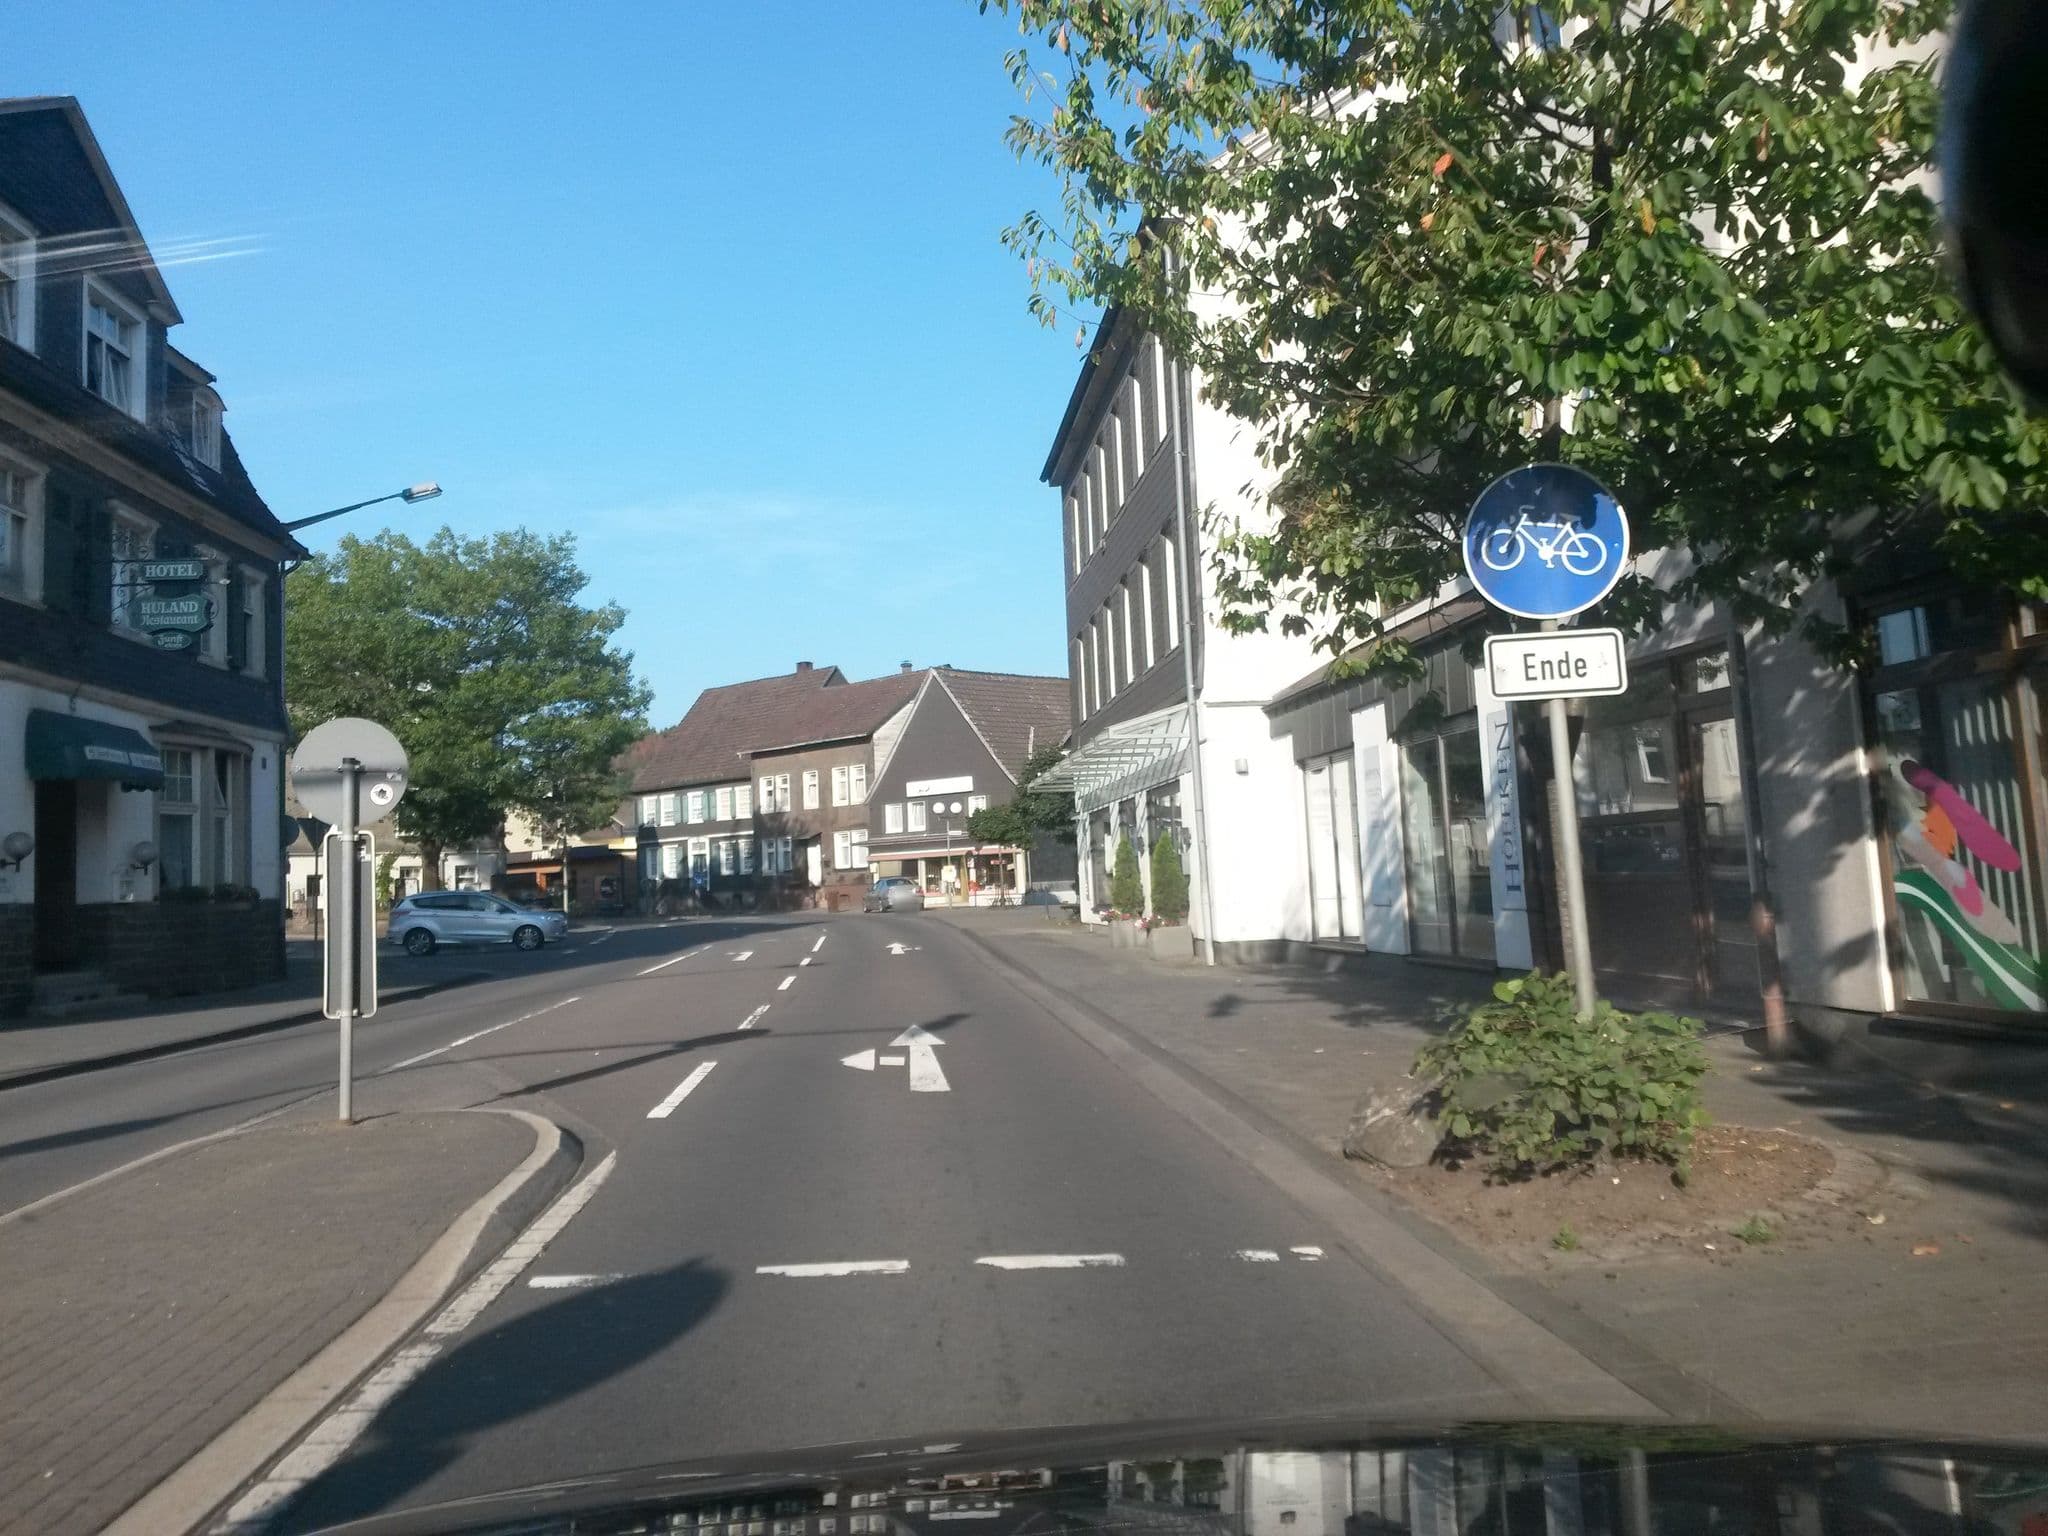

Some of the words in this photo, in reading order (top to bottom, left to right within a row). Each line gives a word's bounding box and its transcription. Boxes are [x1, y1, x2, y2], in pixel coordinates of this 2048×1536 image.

[144, 564, 197, 577] HOTEL
[141, 601, 198, 613] HULAND
[141, 614, 199, 626] Restaurant
[1523, 651, 1588, 681] Ende
